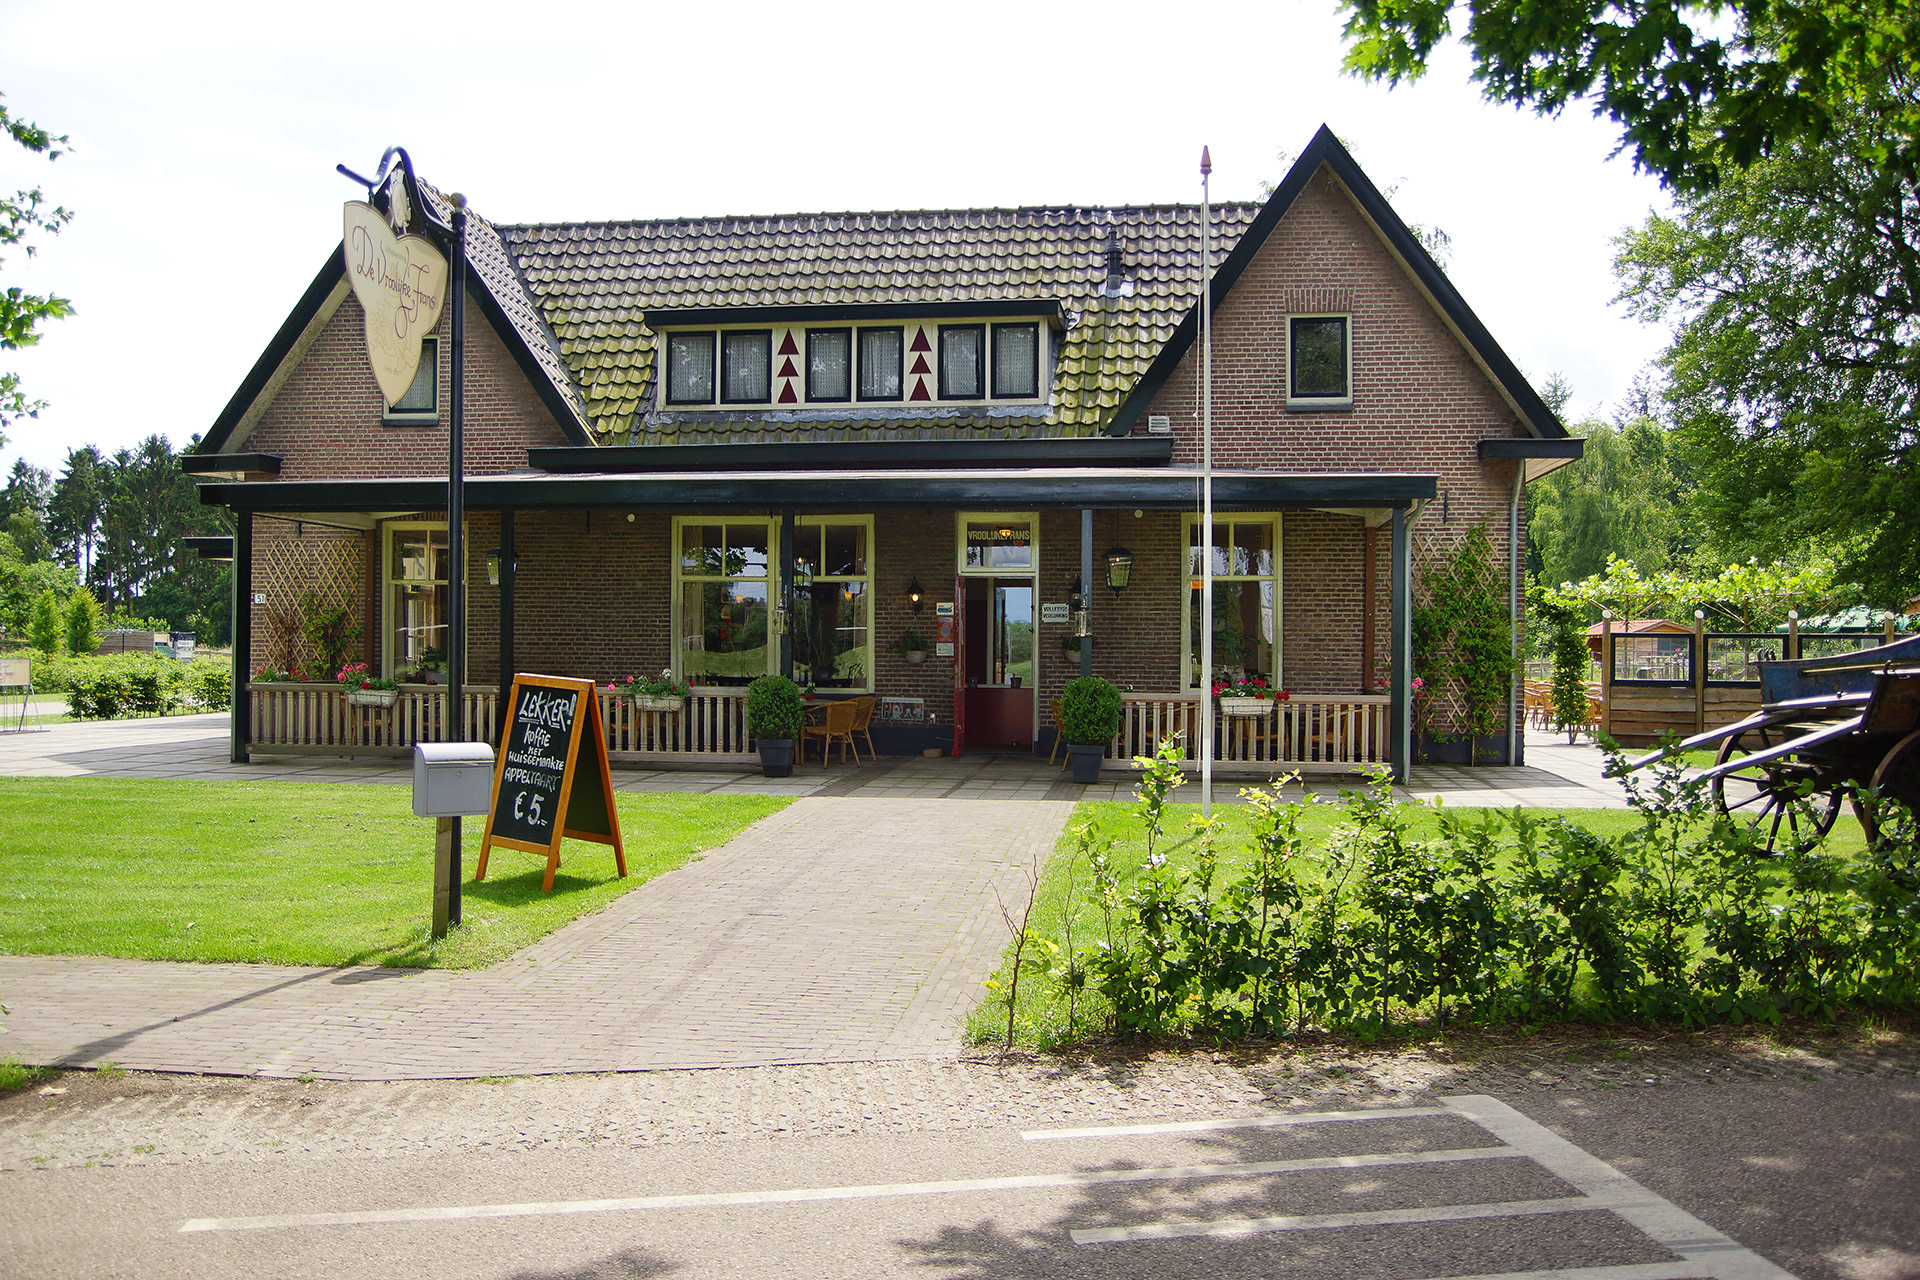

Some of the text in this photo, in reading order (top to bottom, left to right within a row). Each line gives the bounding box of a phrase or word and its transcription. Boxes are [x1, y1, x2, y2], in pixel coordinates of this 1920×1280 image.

[352, 226, 375, 280] De
[408, 263, 437, 323] Frans
[519, 691, 577, 732] LEKKER!
[528, 746, 544, 756] MET
[504, 767, 561, 792] APPELTAART
